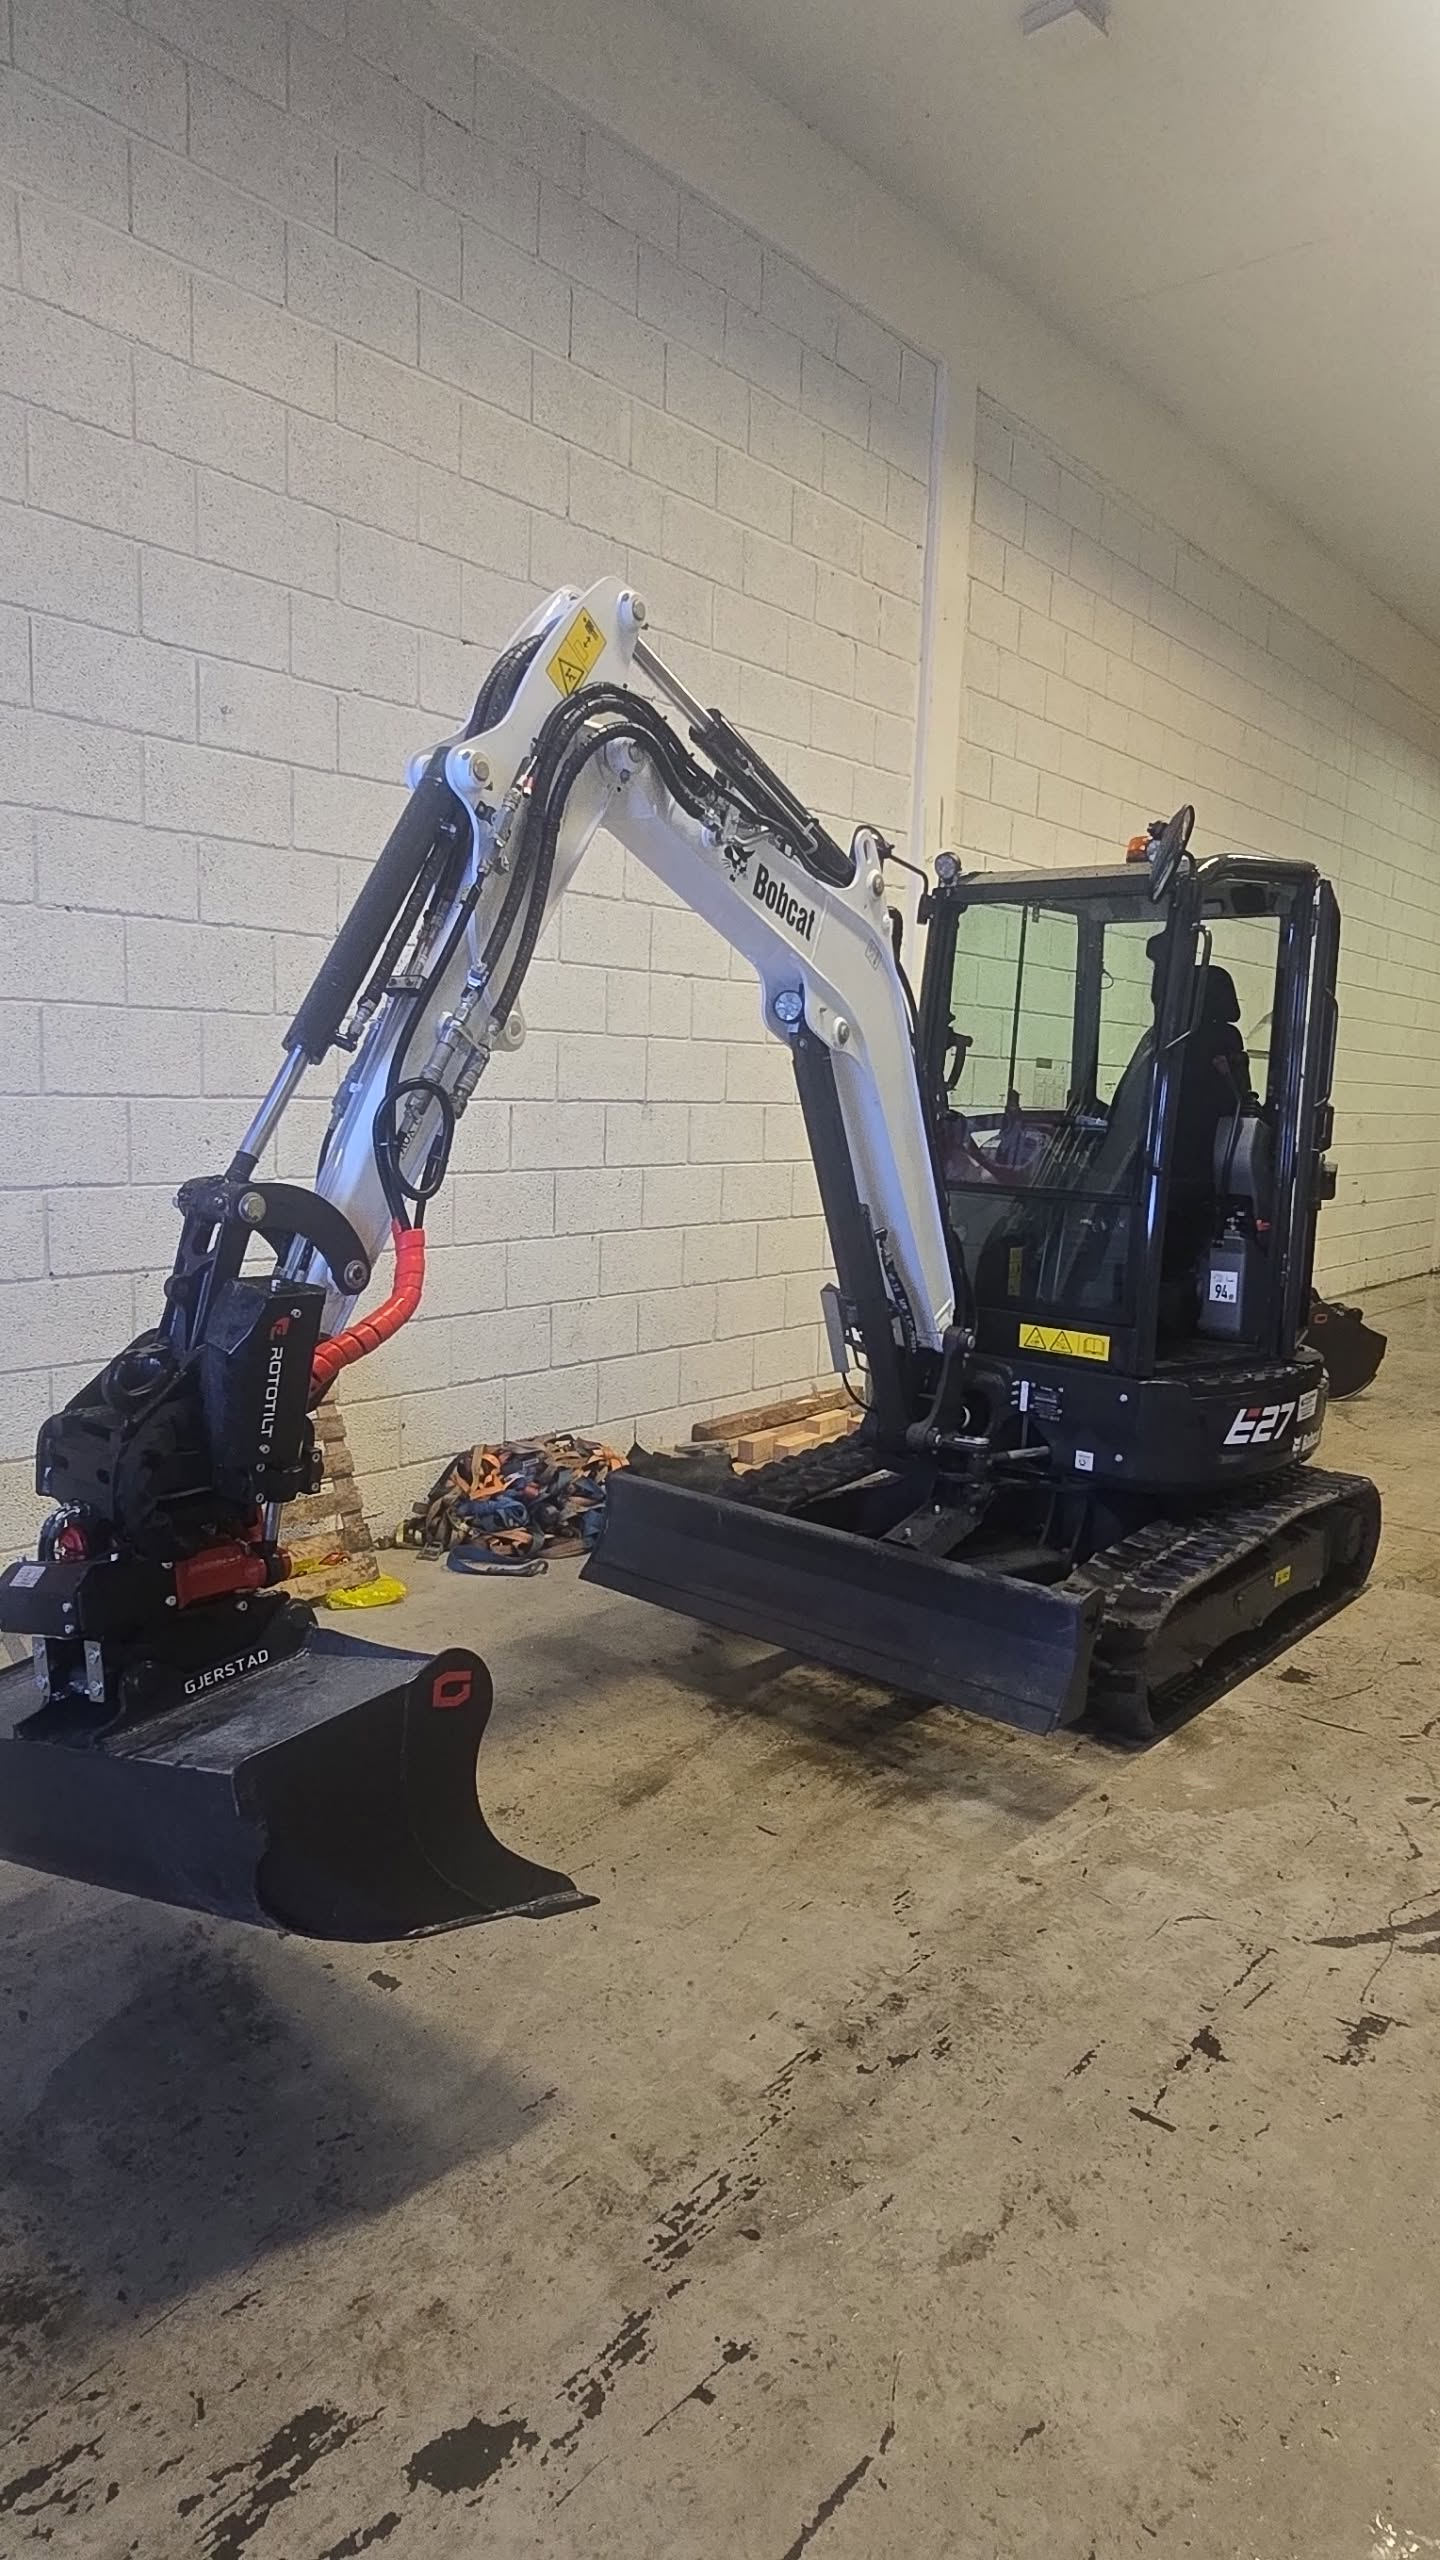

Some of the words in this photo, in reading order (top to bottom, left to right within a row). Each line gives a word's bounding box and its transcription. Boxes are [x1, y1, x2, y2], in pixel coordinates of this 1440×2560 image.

[752, 863, 816, 942] Bobcat
[1215, 1284, 1228, 1299] 94
[260, 1346, 284, 1439] ROTOTILT
[1223, 1401, 1297, 1445] E27
[184, 1649, 269, 1694] GJERSTAD
